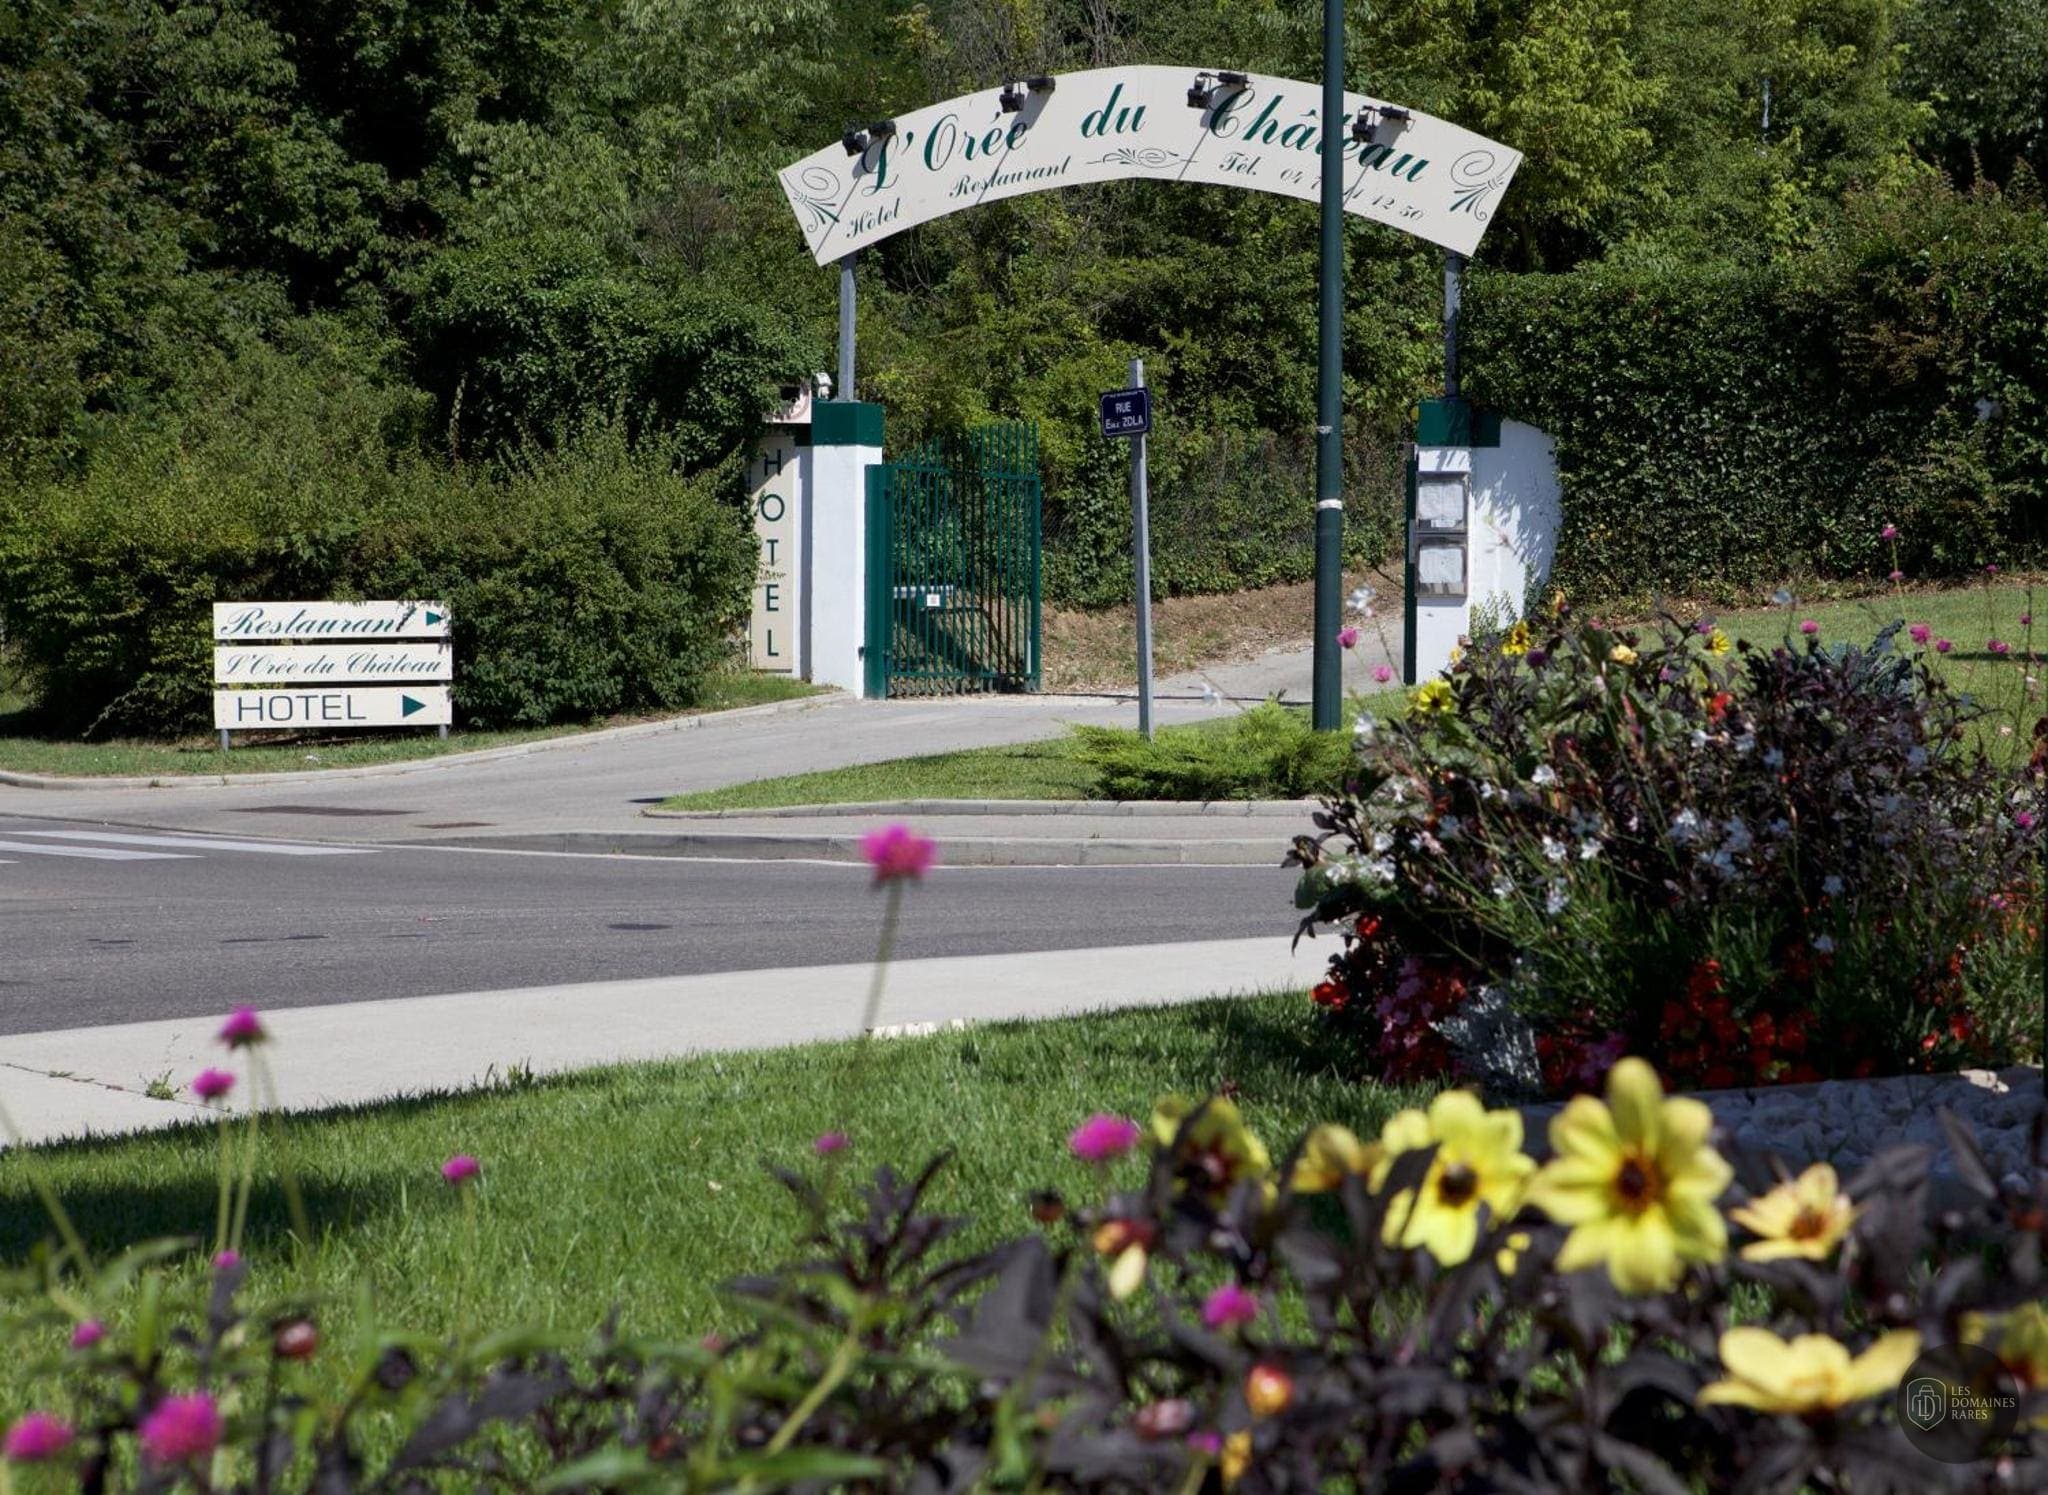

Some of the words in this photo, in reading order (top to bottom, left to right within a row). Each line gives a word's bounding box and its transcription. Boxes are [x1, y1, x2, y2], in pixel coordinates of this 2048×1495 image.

[862, 111, 1027, 197] L'Orée
[1081, 82, 1146, 138] du
[1208, 84, 1430, 182] Châeau
[846, 197, 900, 238] Hôtel
[949, 156, 1071, 199] Restaurant
[760, 448, 786, 657] HOTEL
[220, 606, 418, 635] Restaurant
[303, 654, 335, 674] du
[346, 651, 442, 674] Château
[237, 694, 367, 722] HOTEL
